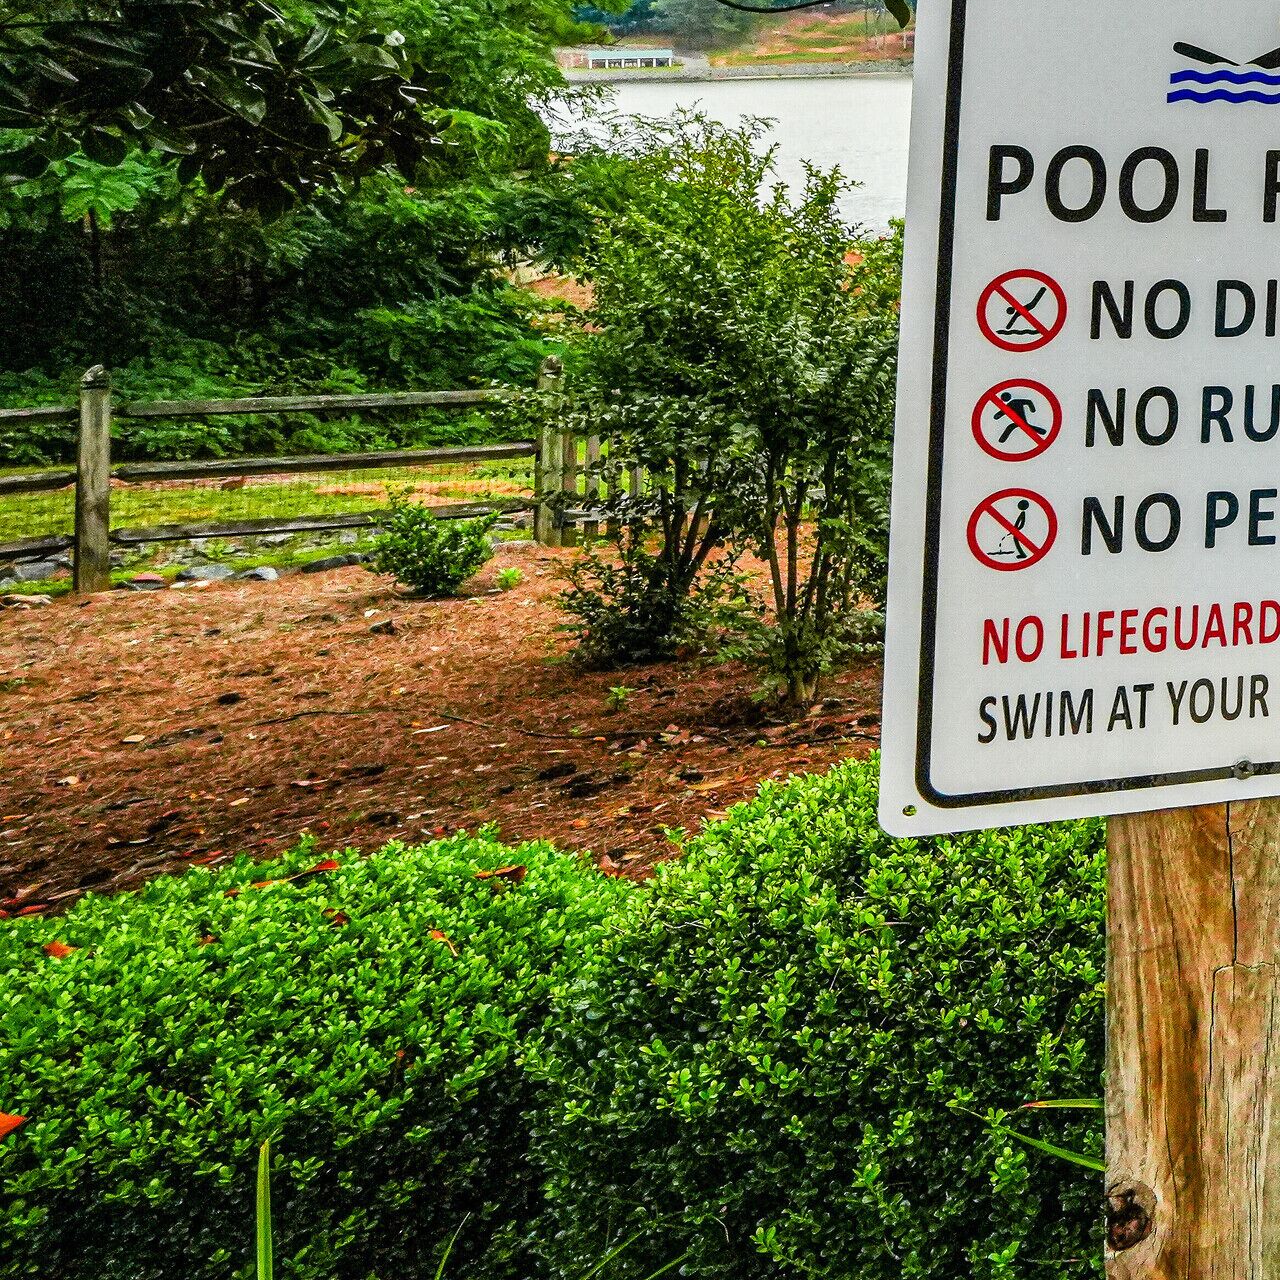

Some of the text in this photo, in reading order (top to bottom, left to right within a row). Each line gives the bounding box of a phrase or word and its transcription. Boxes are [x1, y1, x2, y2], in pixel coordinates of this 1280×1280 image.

[986, 145, 1227, 223] POOL
[1090, 279, 1191, 339] NO
[1085, 386, 1178, 447] NO
[1082, 493, 1181, 555] NO
[983, 616, 1044, 665] NO
[978, 689, 1093, 744] SWIM
[1107, 683, 1154, 731] AT
[1166, 674, 1269, 725] YOUR
